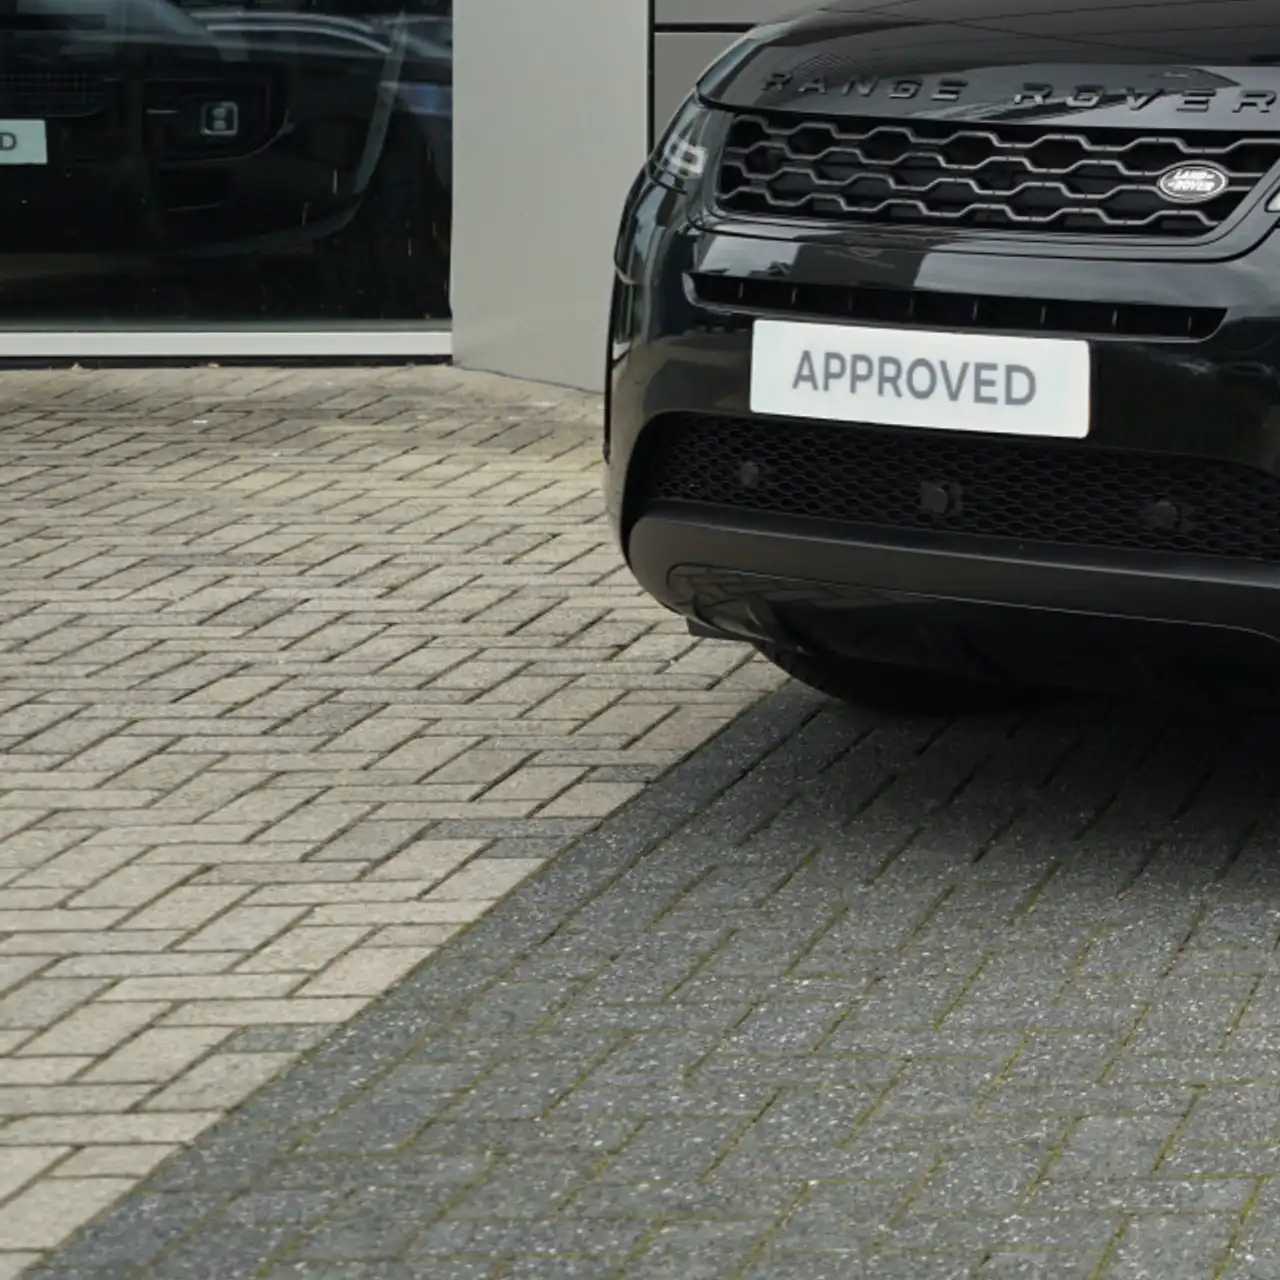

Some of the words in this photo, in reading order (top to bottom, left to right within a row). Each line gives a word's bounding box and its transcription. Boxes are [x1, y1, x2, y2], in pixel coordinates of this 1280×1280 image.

[763, 73, 968, 102] RANGE
[1014, 82, 1277, 113] ROVER
[792, 350, 1037, 407] APPROVED
